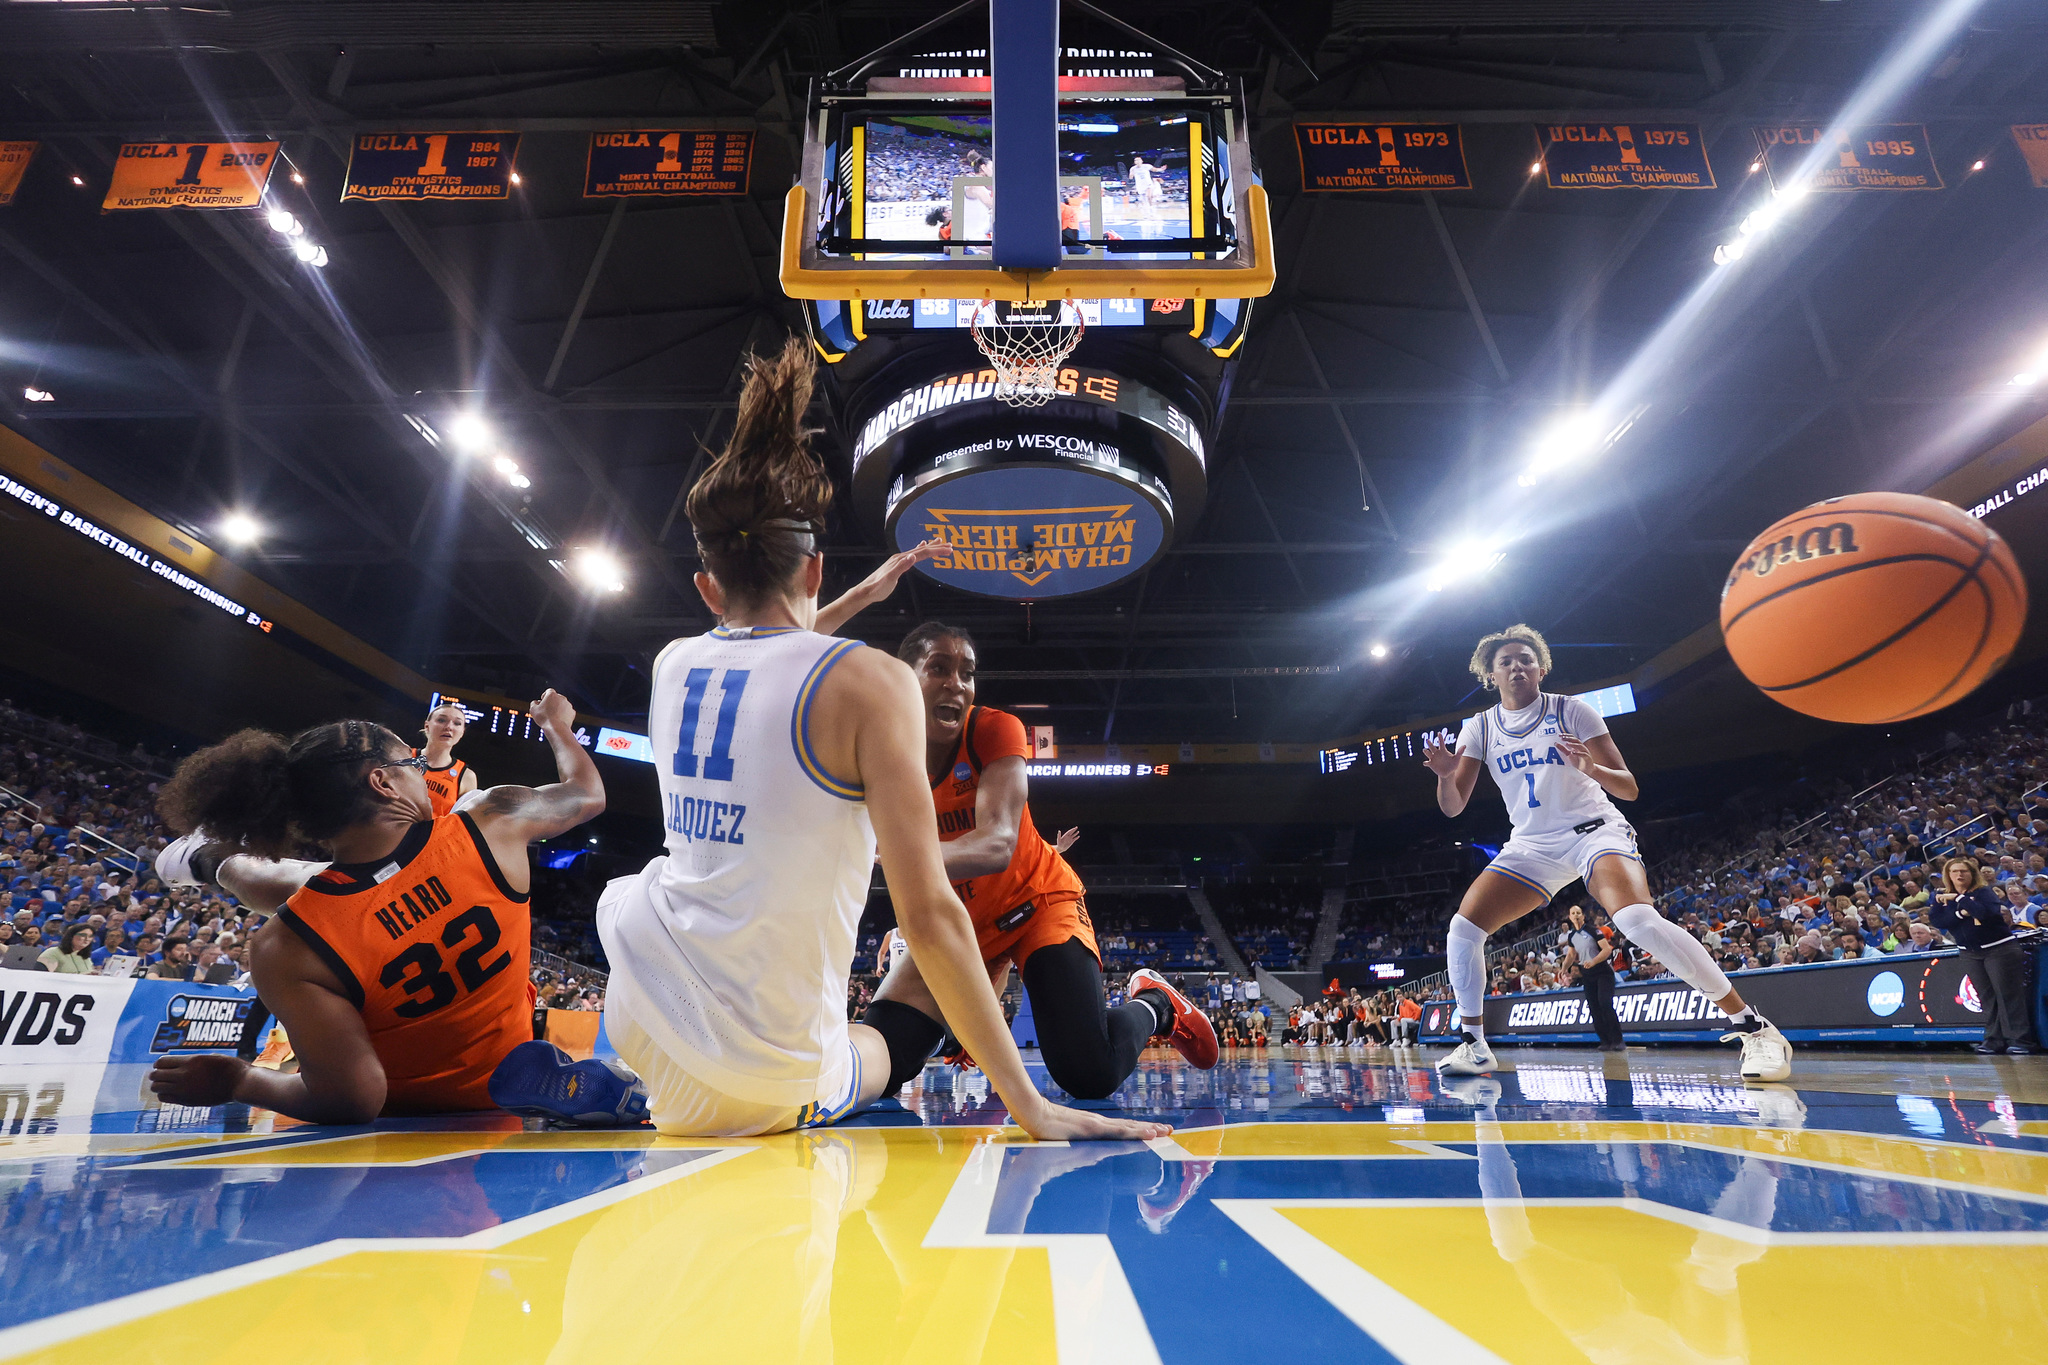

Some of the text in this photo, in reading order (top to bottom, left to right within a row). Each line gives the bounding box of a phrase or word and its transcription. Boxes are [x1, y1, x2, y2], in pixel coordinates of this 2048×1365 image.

[1404, 132, 1449, 147] 1973
[1548, 126, 1641, 164] UCLA 1
[1644, 131, 1690, 145] 1975
[470, 142, 500, 152] 1984
[596, 132, 682, 172] UCLA 1
[1307, 127, 1400, 166] UCLA 1
[1866, 141, 1915, 156] 1995
[359, 135, 448, 175] UCLA 1
[466, 156, 497, 167] 1987
[121, 145, 208, 185] UCLA 1
[1347, 167, 1423, 175] BASKETBALL
[392, 176, 462, 185] GYMNASTICS
[620, 173, 650, 181] MEN'S
[1317, 175, 1455, 186] NATIONAL CHAMPIONS
[1561, 173, 1700, 183] NATIONAL CHAMPIONS
[1857, 175, 1927, 186] CHAMPIONS
[149, 186, 223, 196] GYMNASTICS
[348, 185, 500, 196] NATIONAL CHAMPIONS
[596, 182, 736, 192] NATIONAL CHAMPIONS
[117, 195, 243, 206] NATIONAL CHAMPIONS
[920, 299, 949, 315] 58
[1108, 299, 1137, 313] 41
[935, 434, 1094, 467] presented by WESCOM
[1054, 449, 1095, 462] Financial
[925, 519, 1137, 549] MADE HERE
[59, 510, 150, 567] BASKETBALL
[150, 560, 246, 617] CHAMPIONSHIP
[934, 544, 1132, 572] CHAMPIONS
[673, 668, 751, 781] 11
[1497, 747, 1565, 774] UCLA
[1026, 764, 1131, 776] ARCH MADNESS
[1525, 773, 1541, 808] 1
[668, 793, 747, 845] JAQUEZ
[374, 876, 452, 940] HEARD
[379, 905, 512, 1019] 32
[184, 999, 237, 1021] MARCH
[1508, 999, 1581, 1027] CELEBRATES
